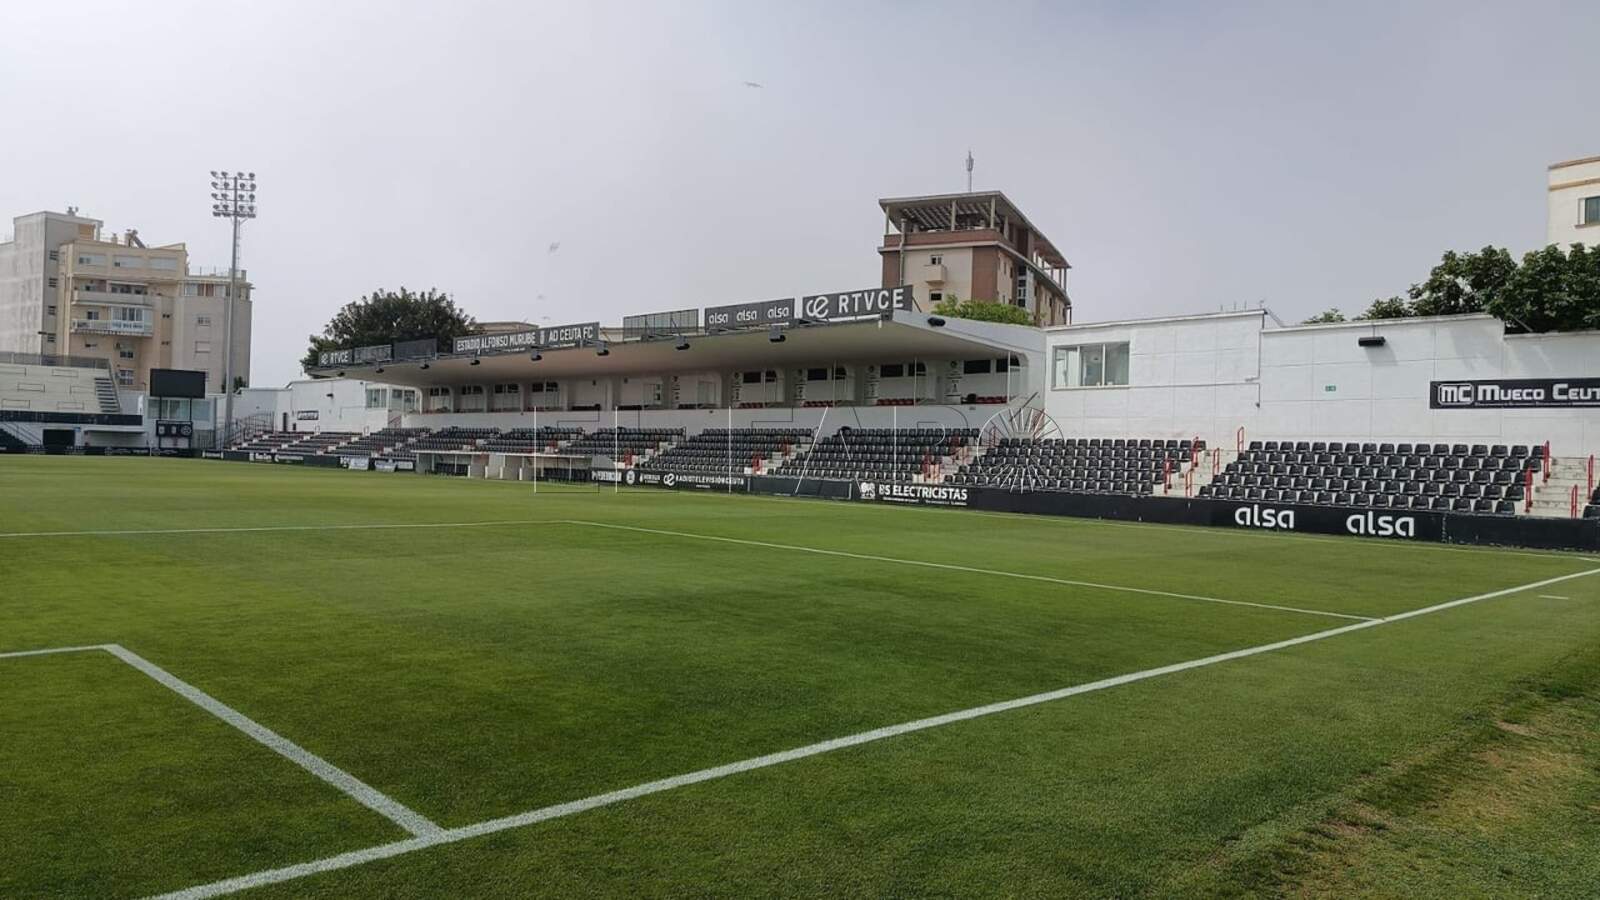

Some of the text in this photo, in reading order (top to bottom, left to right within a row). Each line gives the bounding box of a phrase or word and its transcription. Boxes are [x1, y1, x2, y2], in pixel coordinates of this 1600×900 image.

[838, 288, 904, 314] RTVCE
[708, 305, 789, 324] alsa alsa alsa
[456, 331, 536, 352] ESTADIO ALFONSO MURUBE
[548, 326, 593, 343] AD CEUTA FC
[1440, 385, 1472, 402] MC
[892, 484, 968, 501] ELECTRICISTAS
[1234, 504, 1295, 529] alsa
[1346, 510, 1415, 537] alsa
